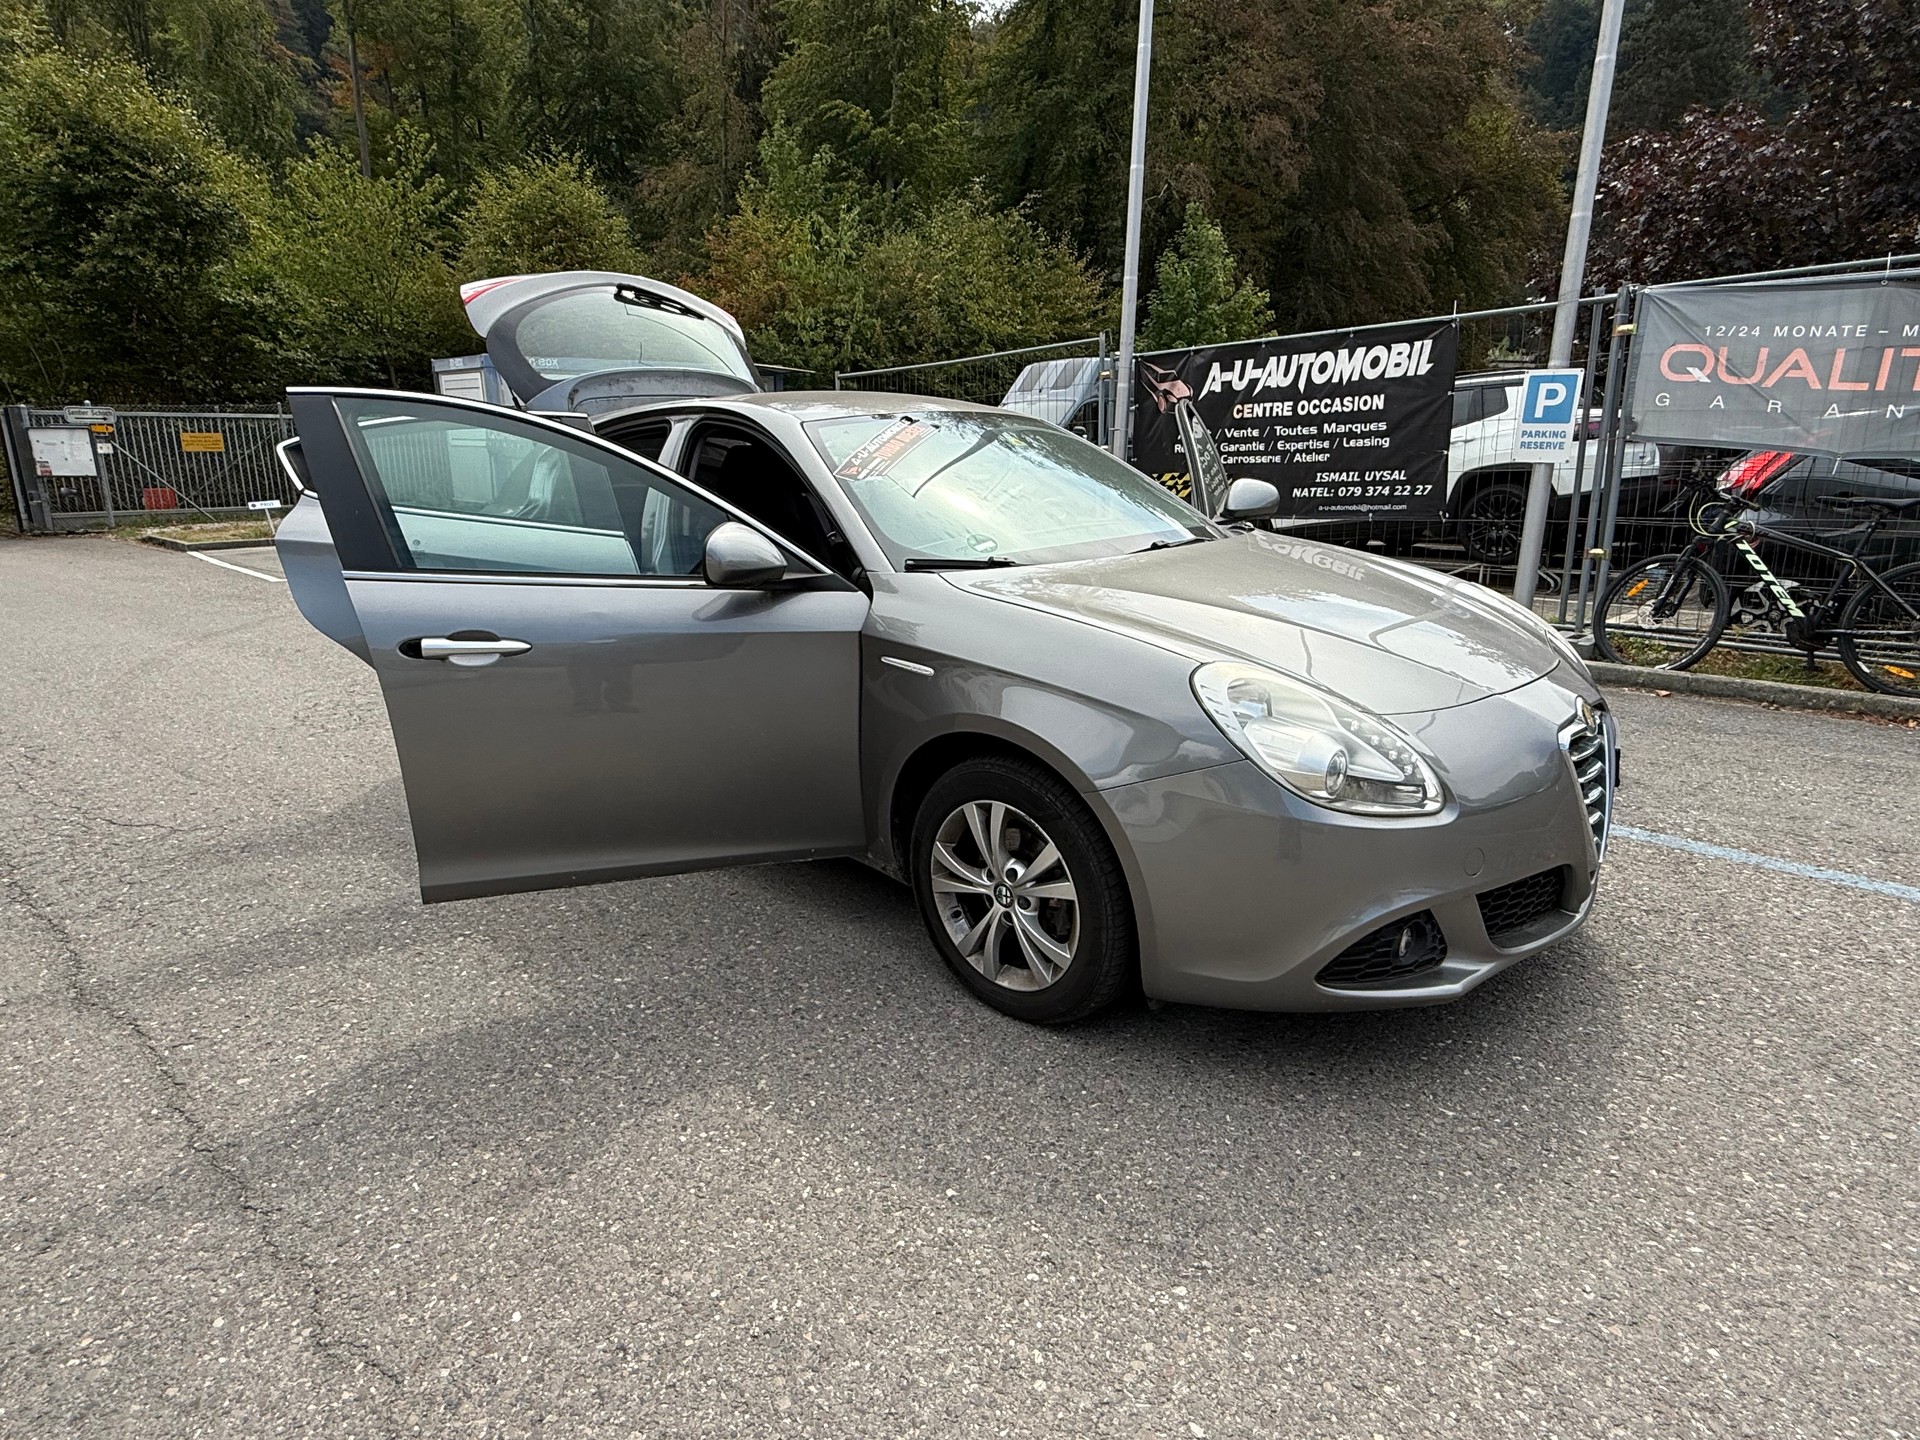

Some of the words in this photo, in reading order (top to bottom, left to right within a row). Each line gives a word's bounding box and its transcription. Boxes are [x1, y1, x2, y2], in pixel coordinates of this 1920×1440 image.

[1704, 325, 1761, 337] 12/24
[1773, 324, 1868, 338] MONATE
[1198, 339, 1435, 401] A-U-AUTOMOBIL
[1233, 401, 1293, 419] CENTRE
[1297, 394, 1385, 416] OCCASION
[1534, 382, 1567, 418] P
[1224, 427, 1260, 438] Vente
[1274, 424, 1318, 436] Toutes
[1323, 421, 1388, 434] Marques
[1521, 430, 1567, 439] PARKING
[1220, 440, 1266, 452] Garantie
[1277, 438, 1330, 452] Expertise
[1343, 435, 1390, 449] Leasing
[1220, 454, 1282, 464] Carrosserie
[1293, 452, 1331, 463] Atelier
[1315, 471, 1361, 482] ISMAIL
[1364, 470, 1407, 481] UYSAL
[1292, 487, 1335, 498] NATEL:
[1338, 486, 1362, 497] 079
[1365, 485, 1390, 496] 374
[1394, 485, 1411, 496] 22
[1414, 485, 1433, 495] 27
[1318, 503, 1408, 512] a-u-automobil@hotmail.com
[1736, 540, 1806, 618] TOTEM
